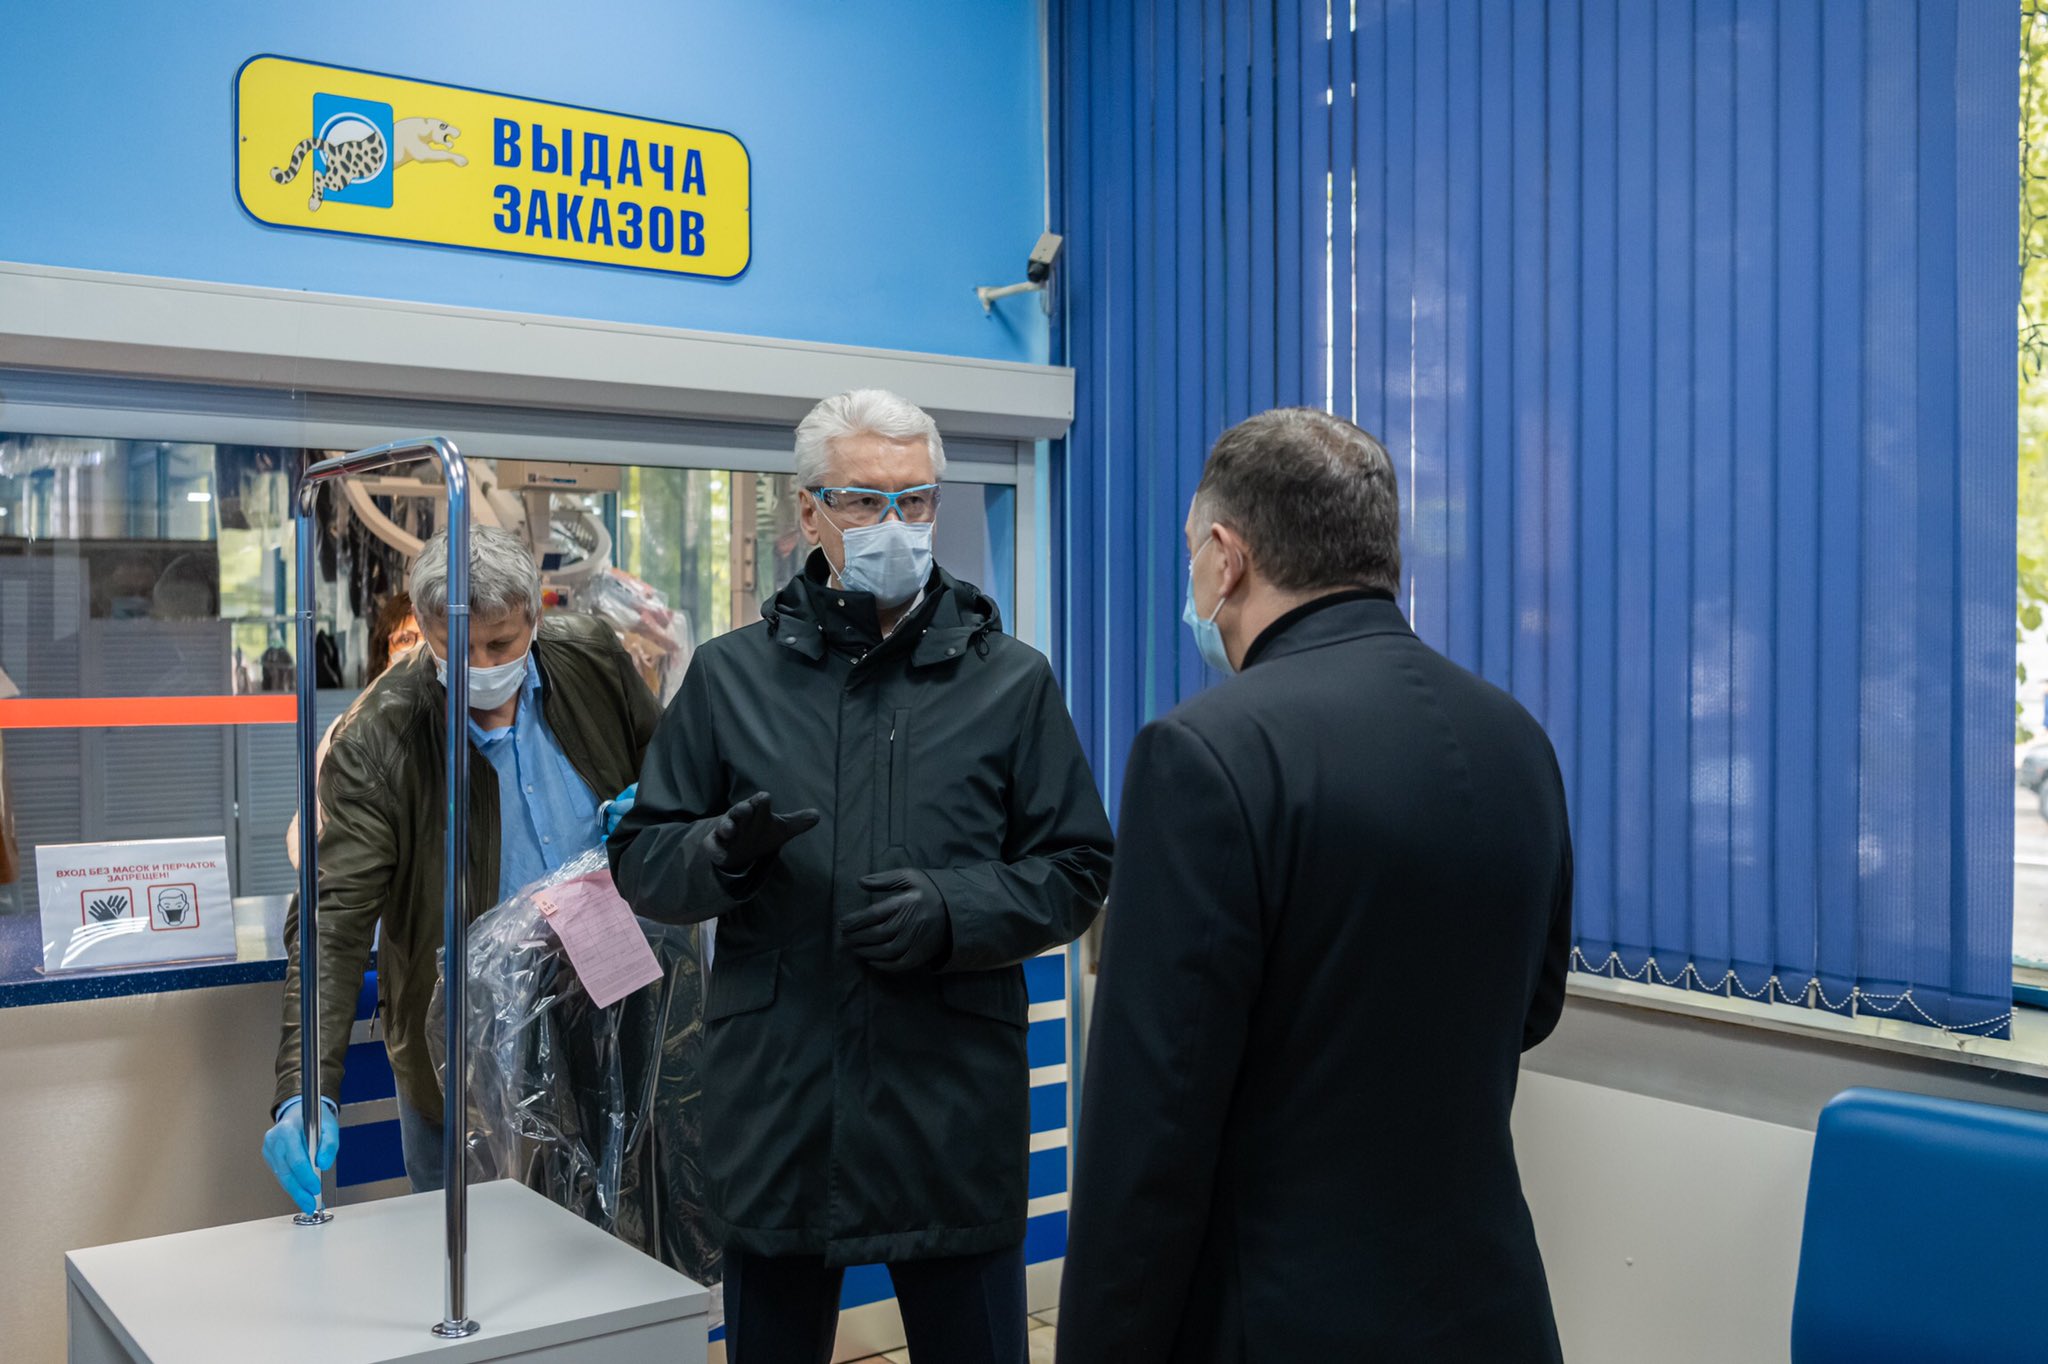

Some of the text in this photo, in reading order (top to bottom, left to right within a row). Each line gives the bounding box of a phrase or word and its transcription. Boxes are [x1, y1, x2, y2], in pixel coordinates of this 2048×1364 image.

[493, 117, 706, 196] ВЫДАЧА
[493, 184, 705, 257] ЗАКАЗОВ
[56, 868, 86, 878] ВХОД
[89, 867, 110, 876] БЕЗ
[113, 864, 150, 874] МАСОК
[162, 861, 216, 871] ПЕРЧАТОК
[107, 872, 170, 883] ЗАПРЕЩЕН!
